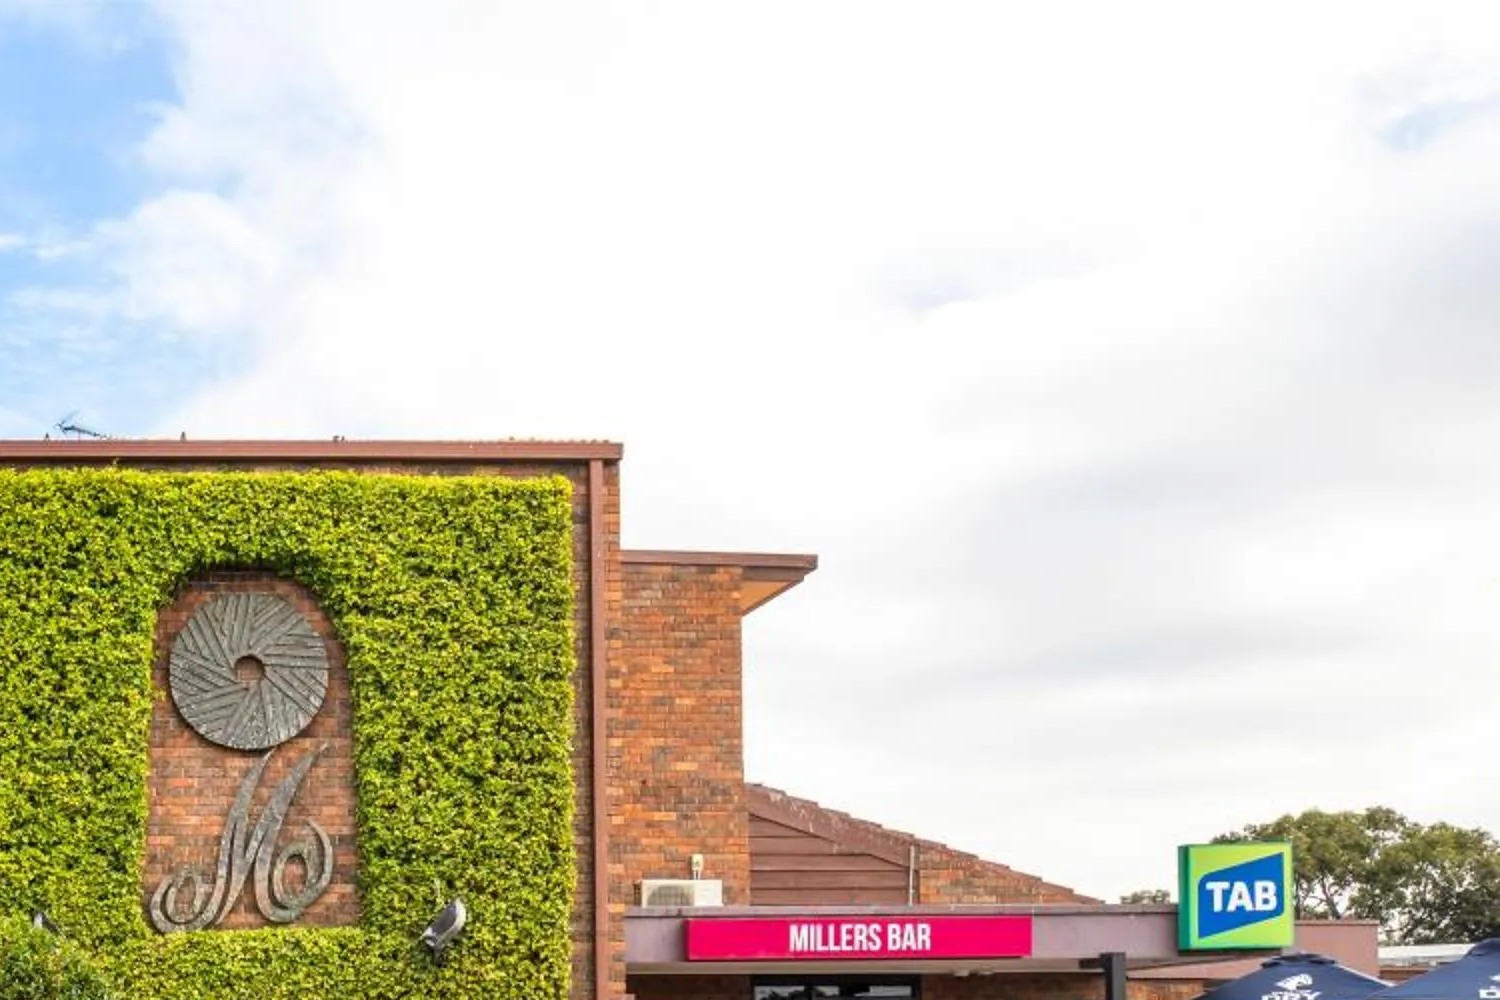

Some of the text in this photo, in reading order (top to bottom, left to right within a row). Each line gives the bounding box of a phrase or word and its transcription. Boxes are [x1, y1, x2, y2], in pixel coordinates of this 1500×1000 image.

[1205, 880, 1278, 912] TAB
[789, 923, 932, 952] MILLERS BAR
